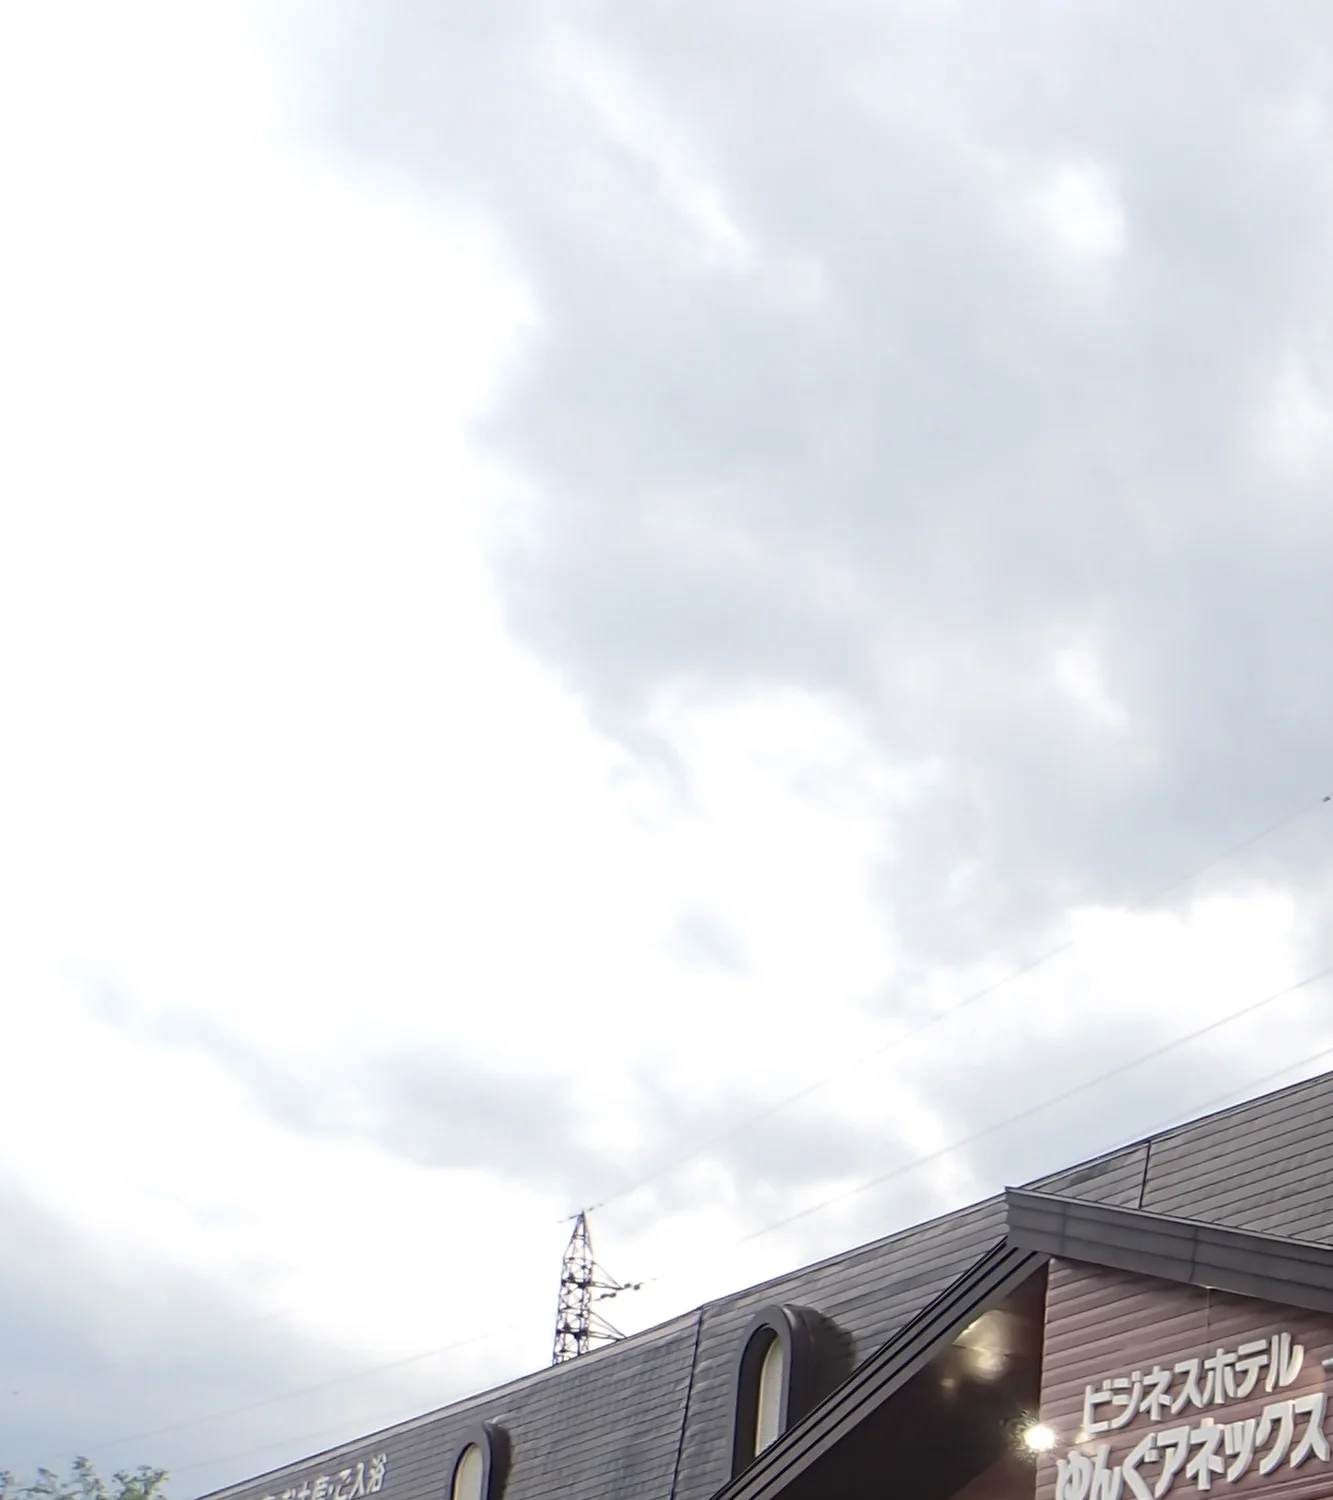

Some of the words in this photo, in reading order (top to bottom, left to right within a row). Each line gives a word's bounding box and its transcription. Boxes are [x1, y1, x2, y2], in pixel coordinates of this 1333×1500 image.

[1084, 1332, 1305, 1435] ビジネスホテル
